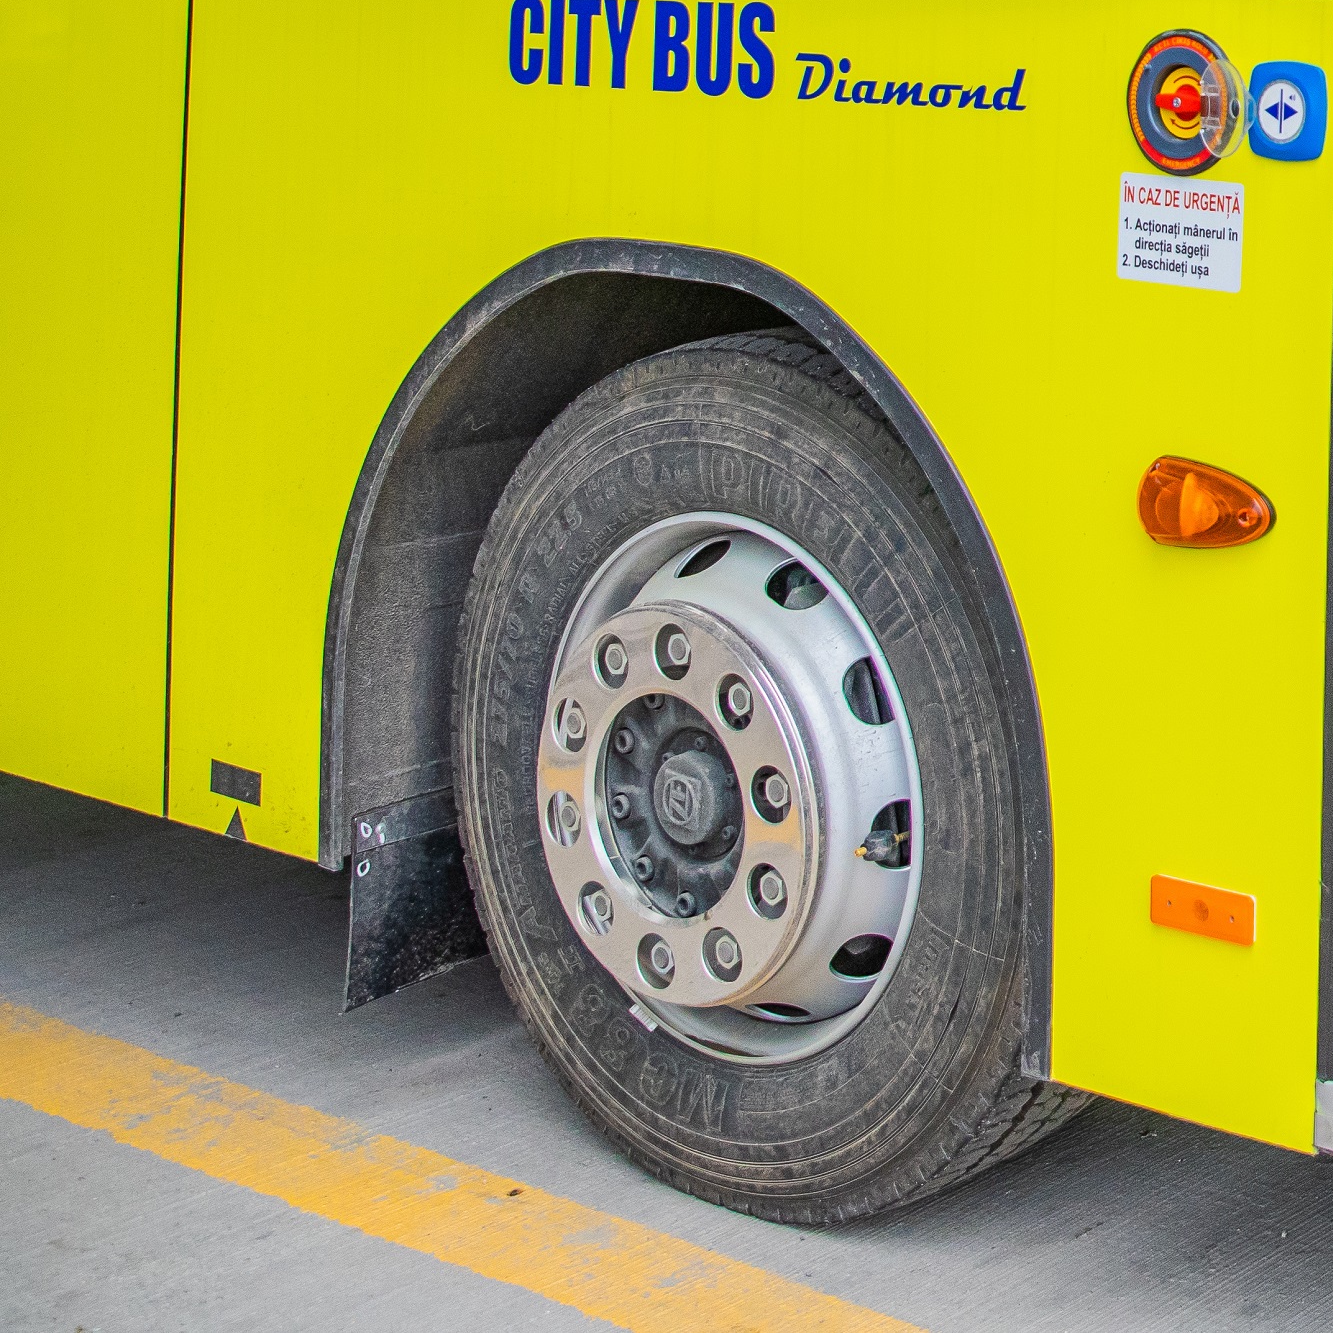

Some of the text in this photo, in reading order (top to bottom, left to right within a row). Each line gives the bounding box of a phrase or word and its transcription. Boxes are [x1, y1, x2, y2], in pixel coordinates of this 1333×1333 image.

[653, 0, 776, 100] BUS
[795, 52, 1027, 111] Diamond
[1124, 180, 1241, 219] ÎN CAZ DE URGENȚĂ
[1124, 217, 1238, 241] 1. Acționați mânerul în
[1134, 237, 1210, 261] direcția săgeții
[1122, 254, 1209, 279] 2. Deschideți ușa
